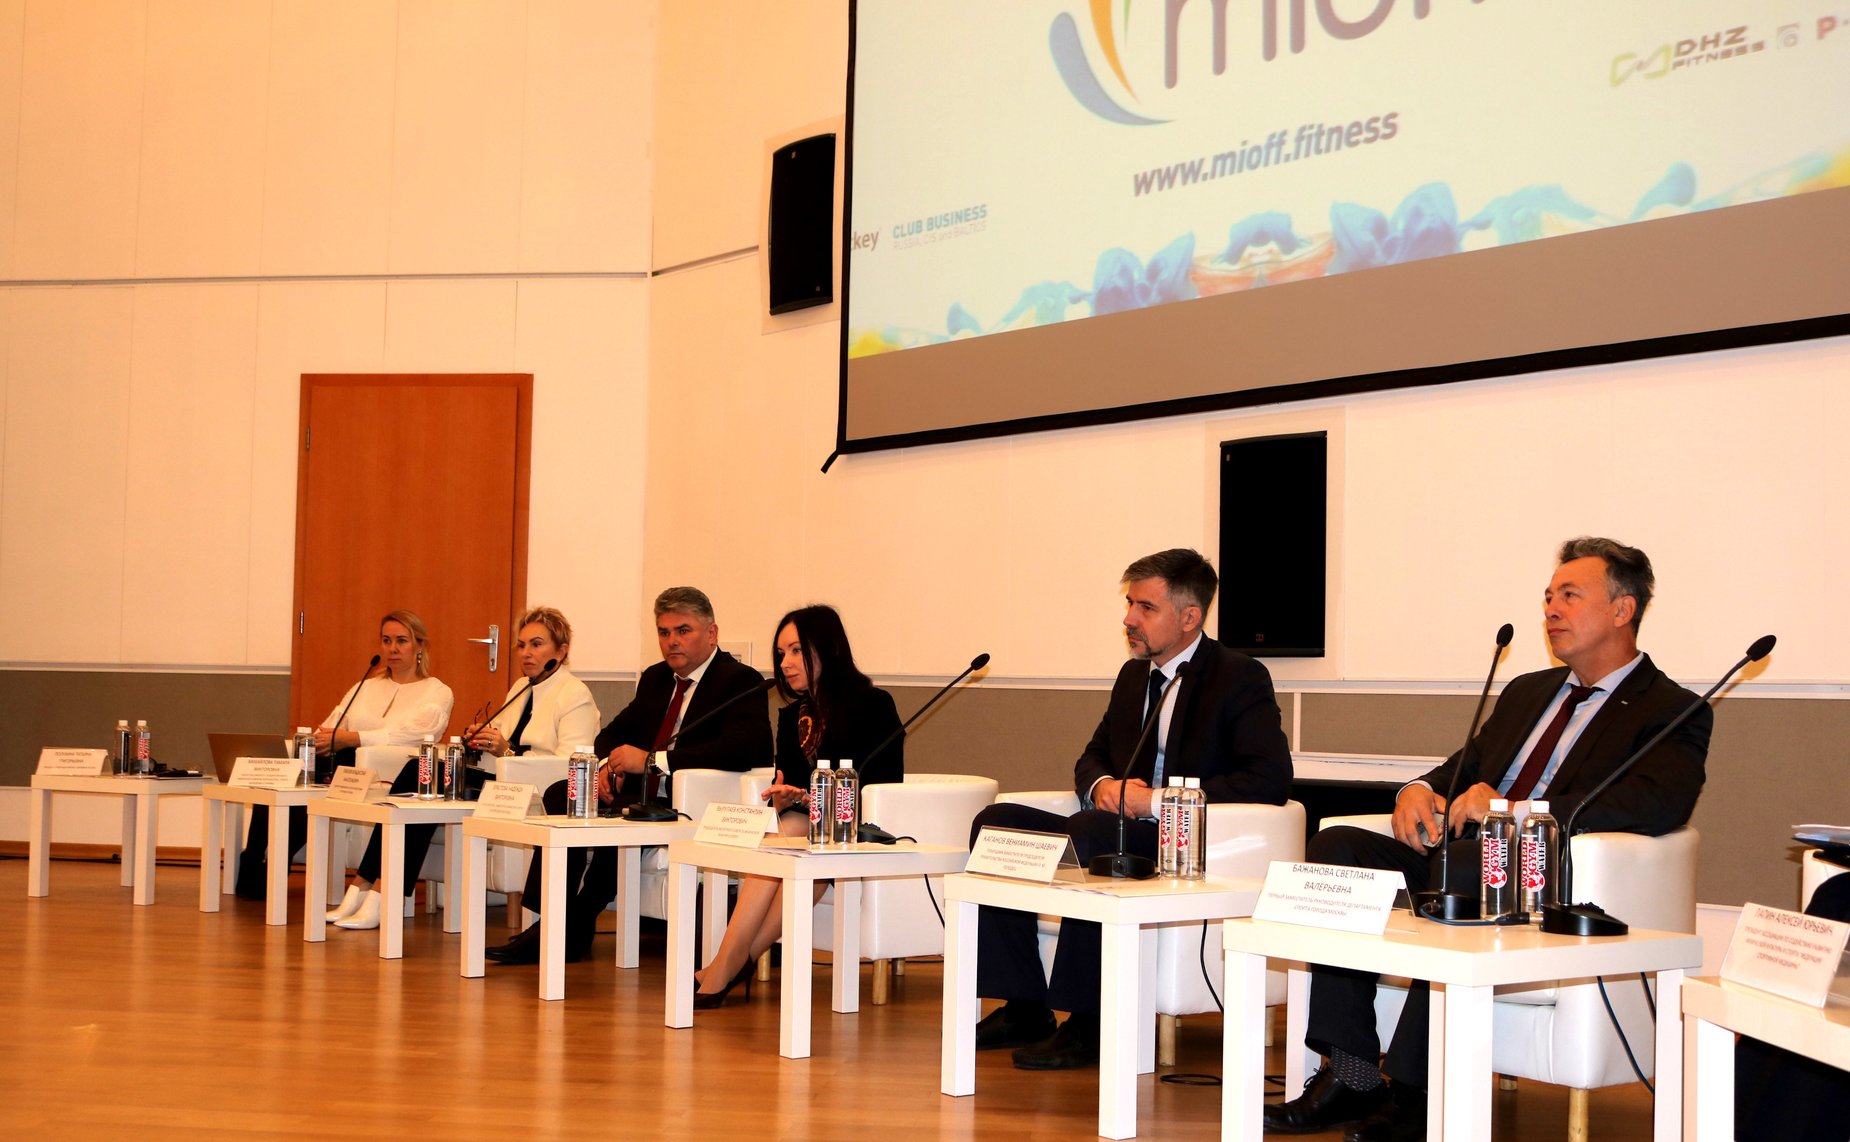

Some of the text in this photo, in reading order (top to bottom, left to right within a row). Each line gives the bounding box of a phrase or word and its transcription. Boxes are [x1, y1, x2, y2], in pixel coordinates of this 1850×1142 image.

[1671, 40, 1766, 71] FITNESS
[1674, 25, 1748, 58] DHZ
[1133, 111, 1399, 197] www.mioff.fitness
[893, 203, 988, 239] CLUB BUSINESS
[850, 231, 880, 251] key
[983, 835, 1059, 851] КАГАНОВ ВЕНИАМИН ШАЕВИЧ
[1490, 839, 1500, 869] GYM
[1528, 841, 1537, 872] GYM
[1538, 841, 1546, 871] WATER
[1292, 863, 1375, 881] БАЖАНОВА СВЕТЛАНА
[1304, 881, 1352, 894] ВАЛЕРЬЕВНА
